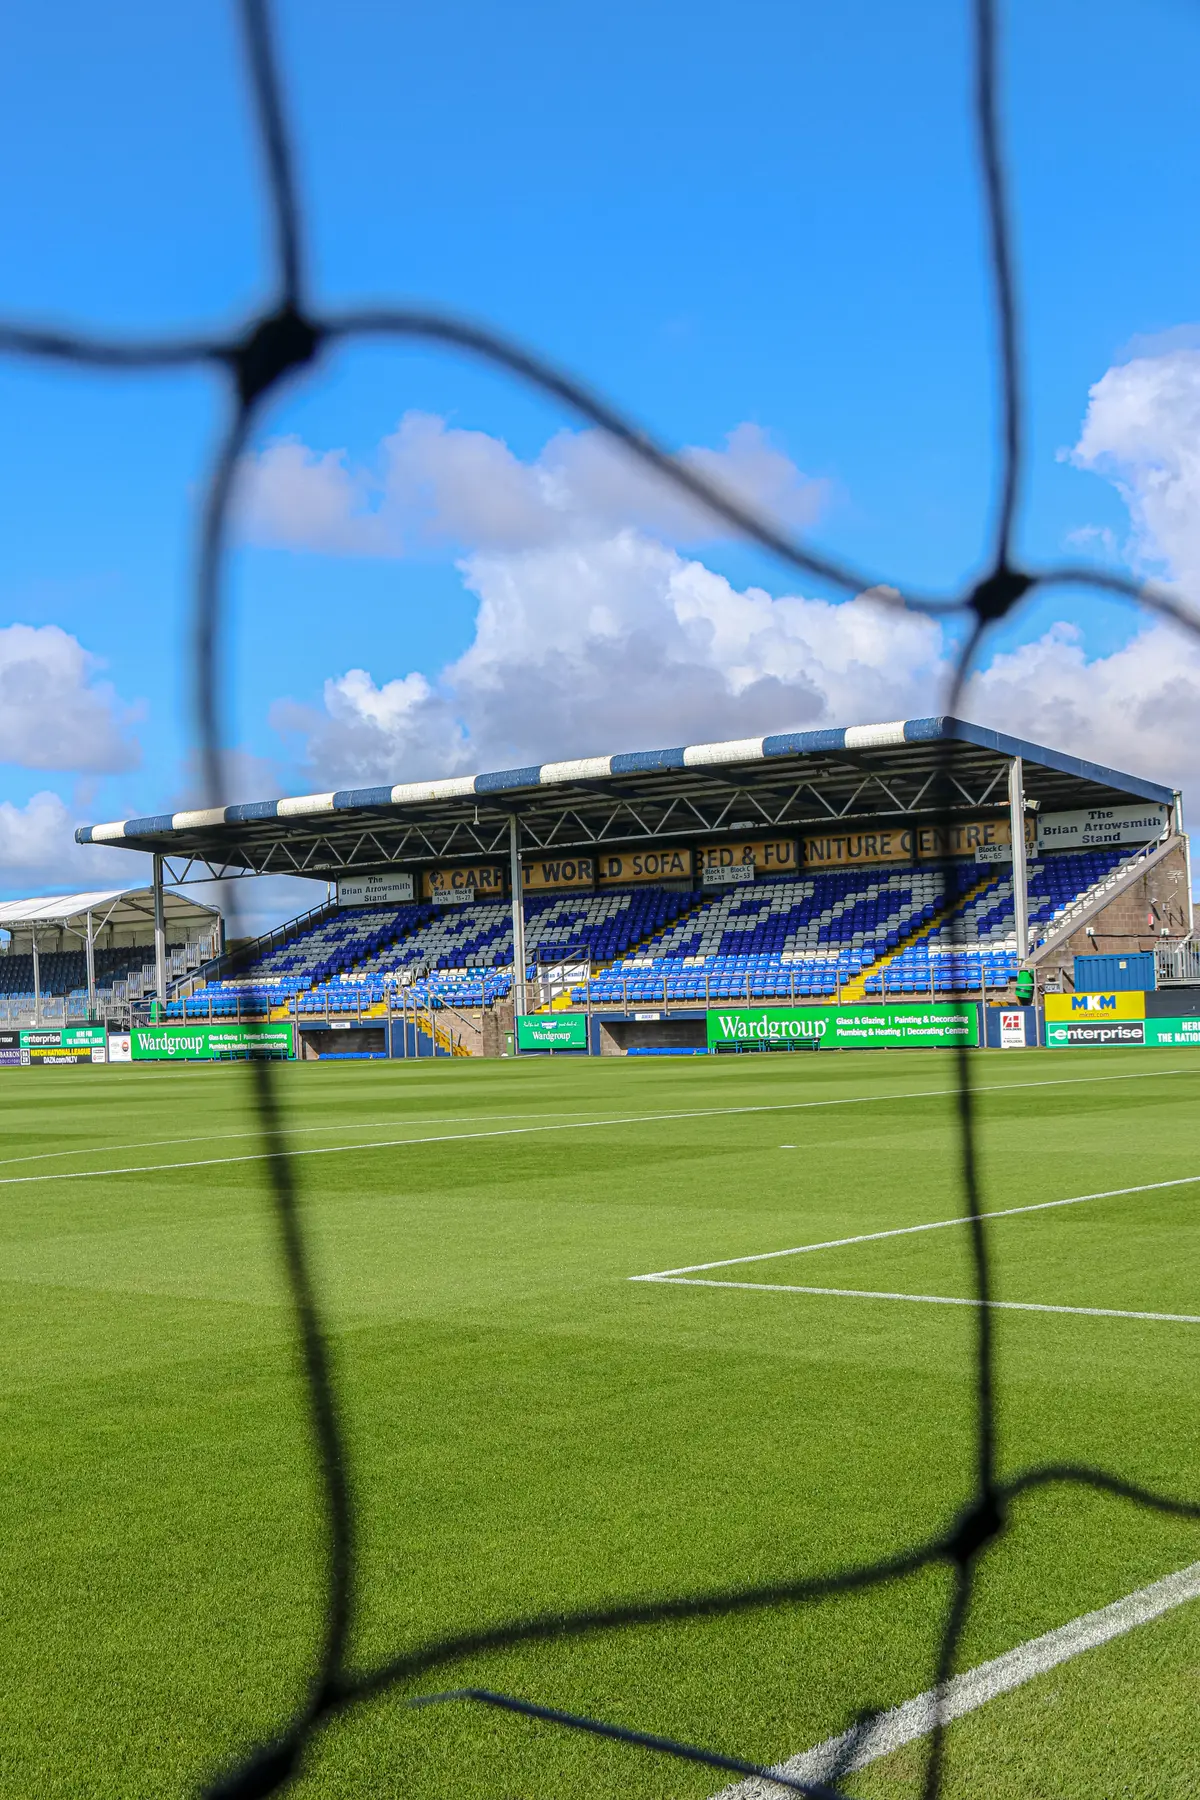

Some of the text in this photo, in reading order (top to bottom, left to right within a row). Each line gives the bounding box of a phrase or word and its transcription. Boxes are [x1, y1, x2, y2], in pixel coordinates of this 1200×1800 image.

[1088, 810, 1114, 820] The
[1043, 817, 1161, 836] Brian Arrowsmith
[1082, 832, 1121, 844] Stand
[451, 864, 534, 889] CARPT
[542, 857, 622, 883] WORD
[633, 852, 685, 876] SOFA
[696, 848, 734, 870] BED
[742, 845, 757, 866] &
[368, 876, 383, 884] The
[341, 883, 410, 896] Brian Arrowsmith
[364, 894, 387, 902] Stand
[1071, 995, 1116, 1010] MKM
[836, 1017, 853, 1025] Glass
[861, 1016, 885, 1025] Glazing
[894, 1016, 922, 1024] Painting
[930, 1015, 968, 1024] Decorating
[1182, 1022, 1200, 1031] HER
[532, 1031, 570, 1042] Wardgroup
[836, 1028, 868, 1037] Plumbing
[875, 1028, 901, 1037] Heating
[907, 1027, 944, 1036] Decorating
[945, 1027, 969, 1035] Centre
[1053, 1027, 1143, 1042] enterprise
[22, 1034, 61, 1044] enterprise
[1157, 1033, 1172, 1042] THE
[137, 1032, 203, 1055] Wardgroup
